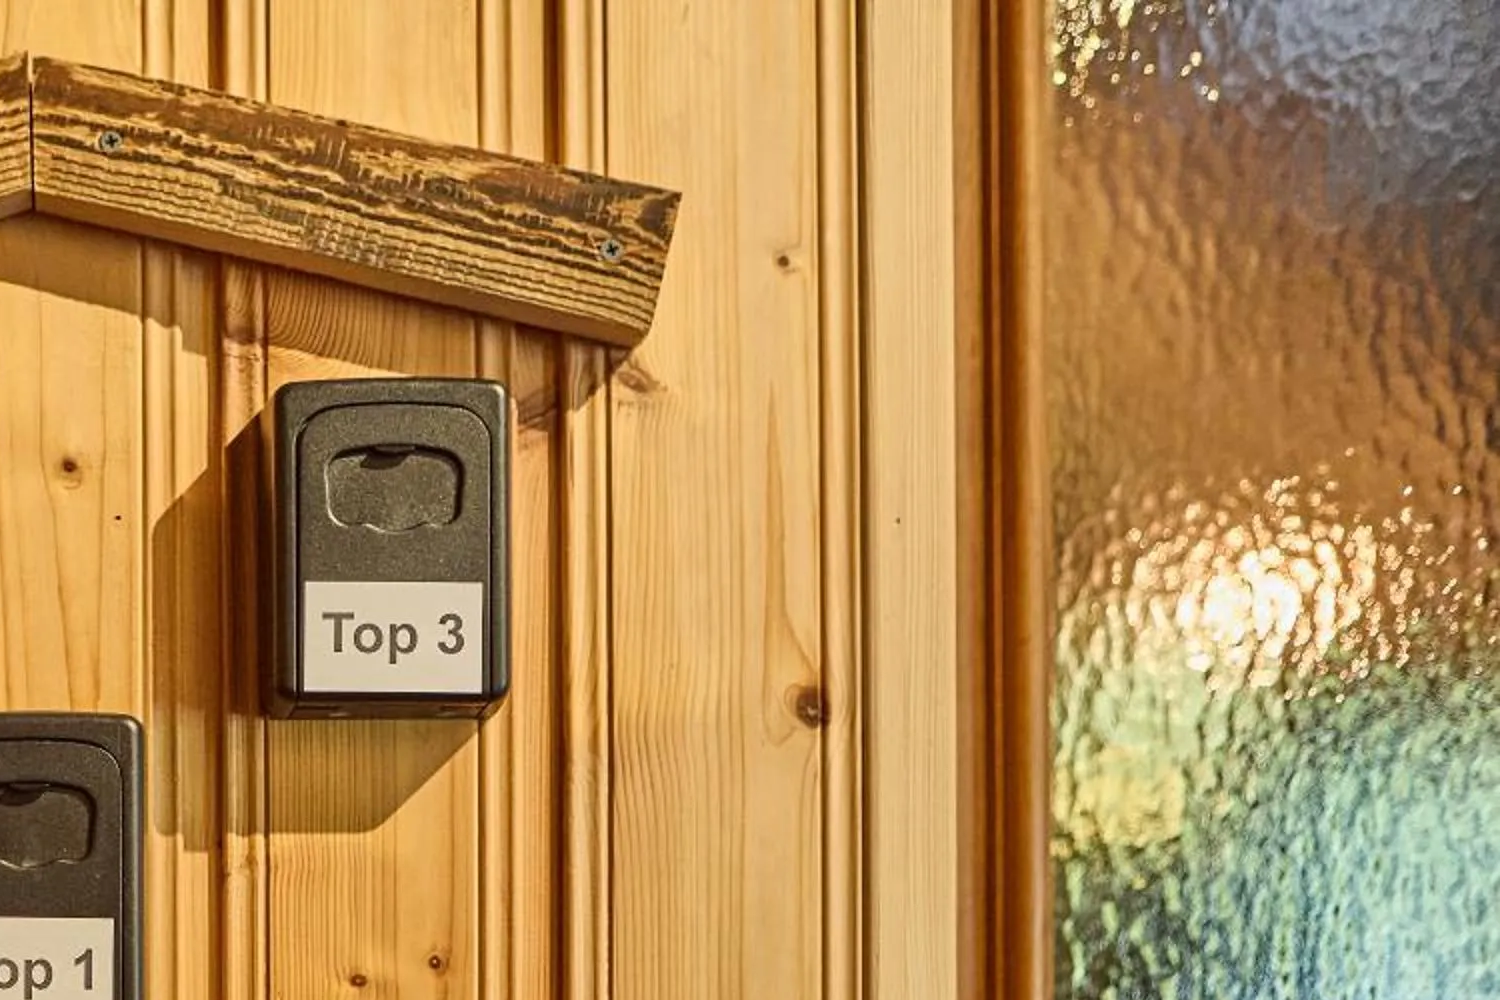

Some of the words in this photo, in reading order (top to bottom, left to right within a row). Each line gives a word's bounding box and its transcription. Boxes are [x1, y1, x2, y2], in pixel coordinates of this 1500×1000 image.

[322, 612, 418, 665] Top
[437, 613, 465, 655] 3
[74, 948, 93, 991] 1
